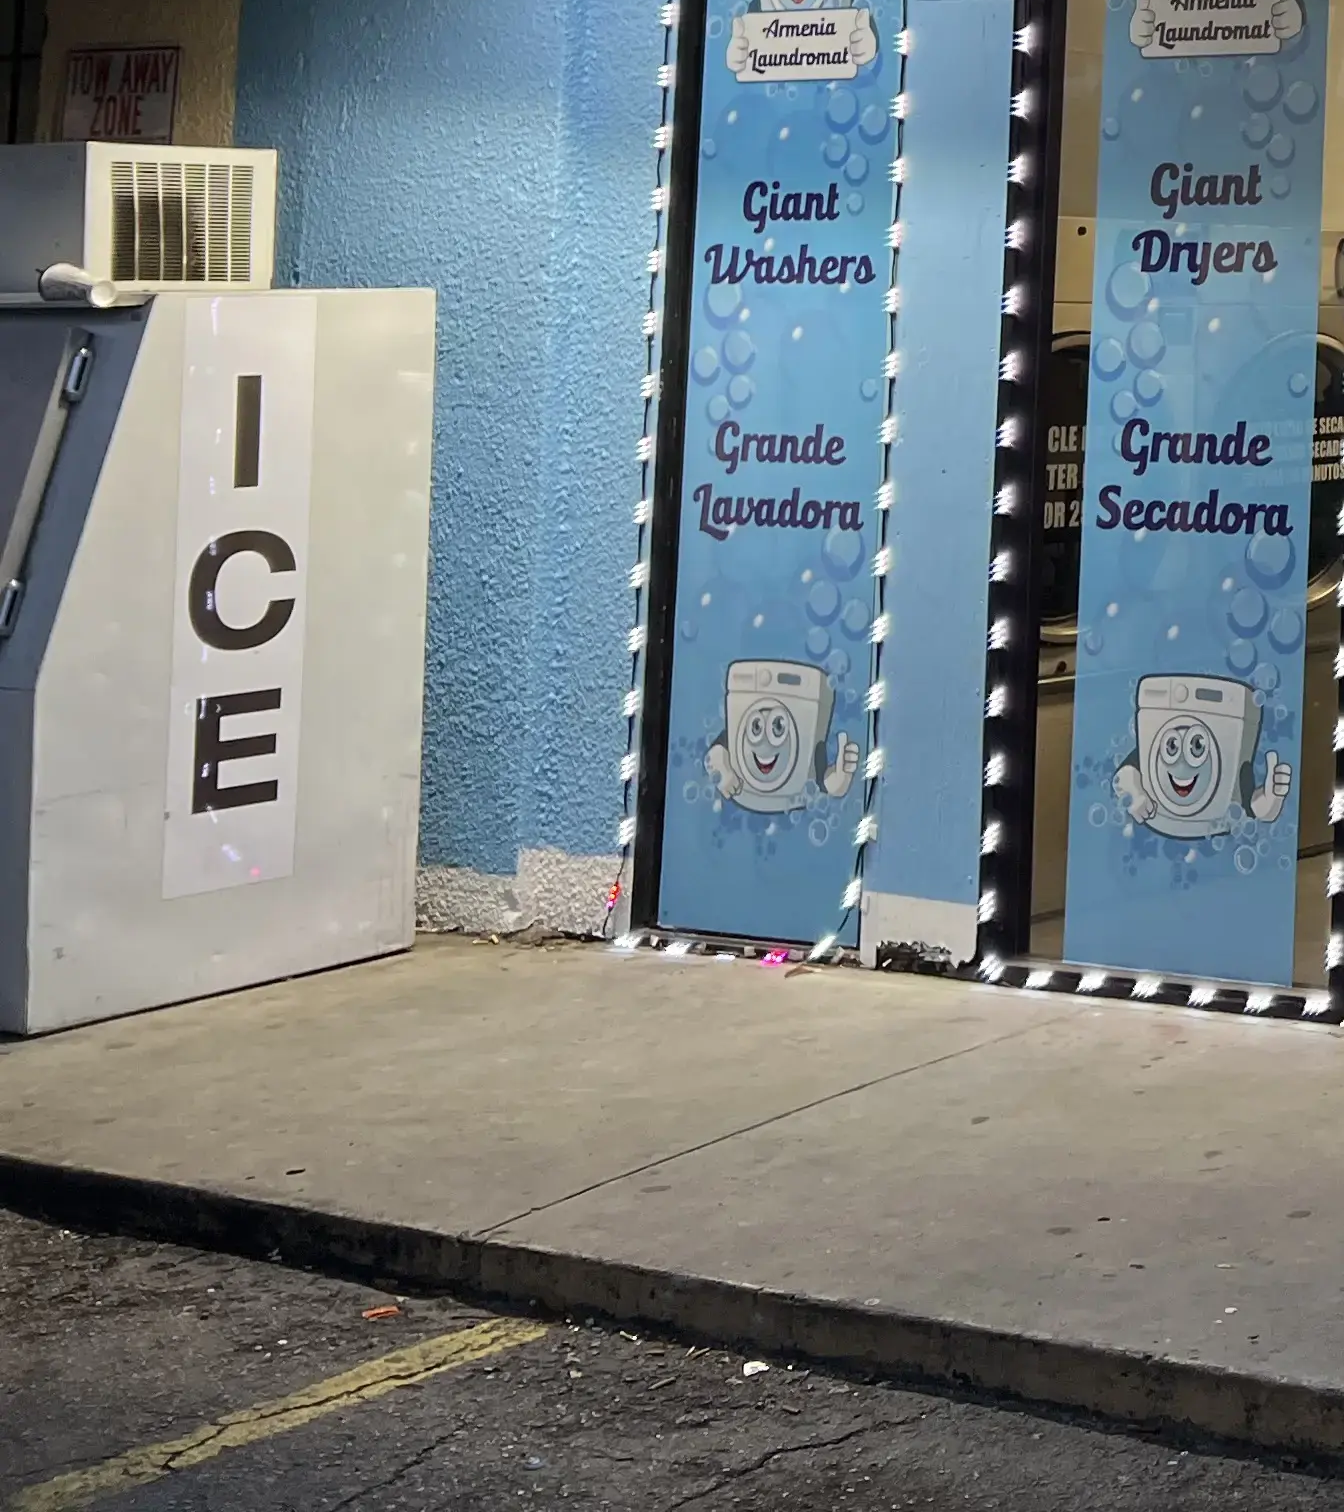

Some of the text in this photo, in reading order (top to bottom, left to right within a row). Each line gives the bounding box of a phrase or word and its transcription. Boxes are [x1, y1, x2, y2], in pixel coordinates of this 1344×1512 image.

[762, 18, 837, 39] Armenia
[1155, 20, 1271, 50] Laundromat
[70, 51, 175, 95] TOW AWAY
[748, 47, 849, 74] Laundromat
[90, 95, 144, 136] ZONE
[743, 181, 840, 233] Giant
[1151, 162, 1262, 219] Giant
[704, 244, 876, 284] Washers
[1132, 230, 1278, 285] Dryers
[715, 421, 847, 474] Grande
[1047, 425, 1078, 453] CLE
[1121, 418, 1273, 476] Grande
[1045, 463, 1079, 491] TER
[693, 483, 864, 541] Lavadora
[1044, 501, 1066, 529] OR
[1096, 484, 1294, 536] Secadora
[188, 374, 297, 816] ICE
